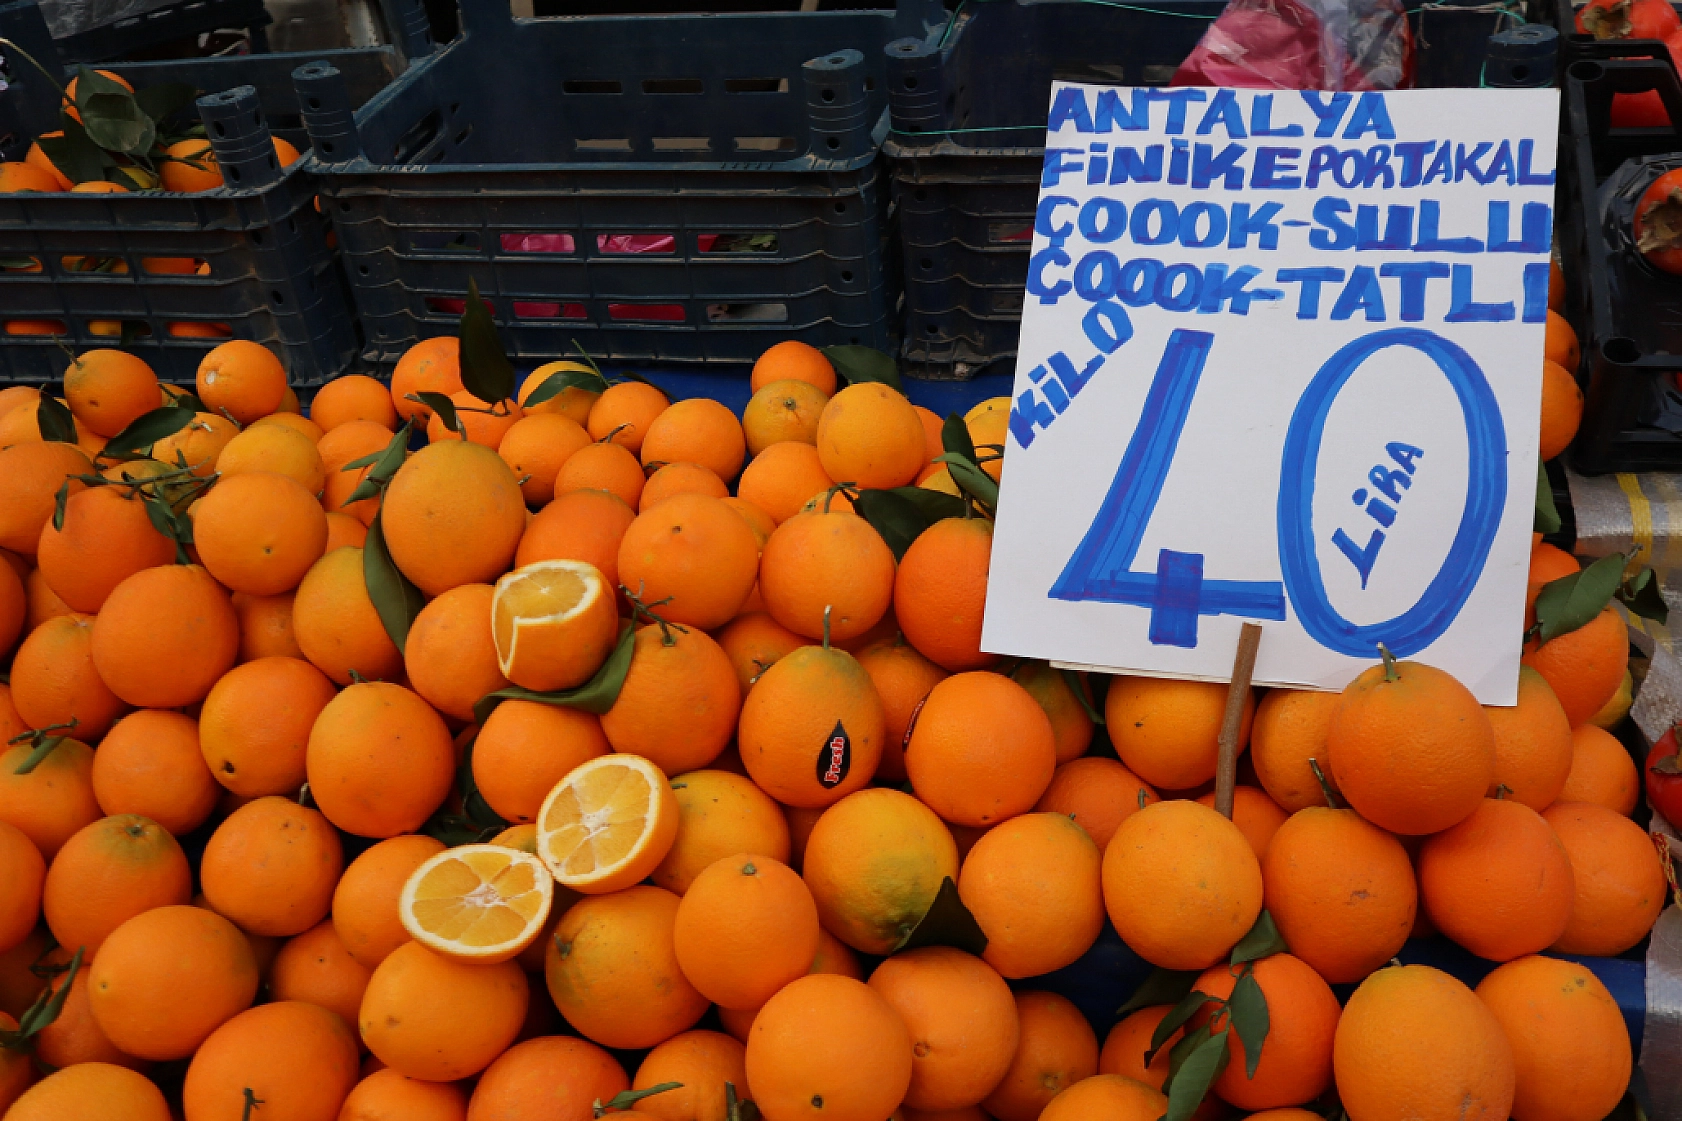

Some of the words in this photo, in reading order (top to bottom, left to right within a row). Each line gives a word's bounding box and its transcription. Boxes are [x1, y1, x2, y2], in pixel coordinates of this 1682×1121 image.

[1047, 87, 1397, 140] ANTALYA
[1304, 138, 1557, 190] PORTAKAL
[1048, 327, 1508, 659] 40
[824, 736, 846, 784] Fresh
